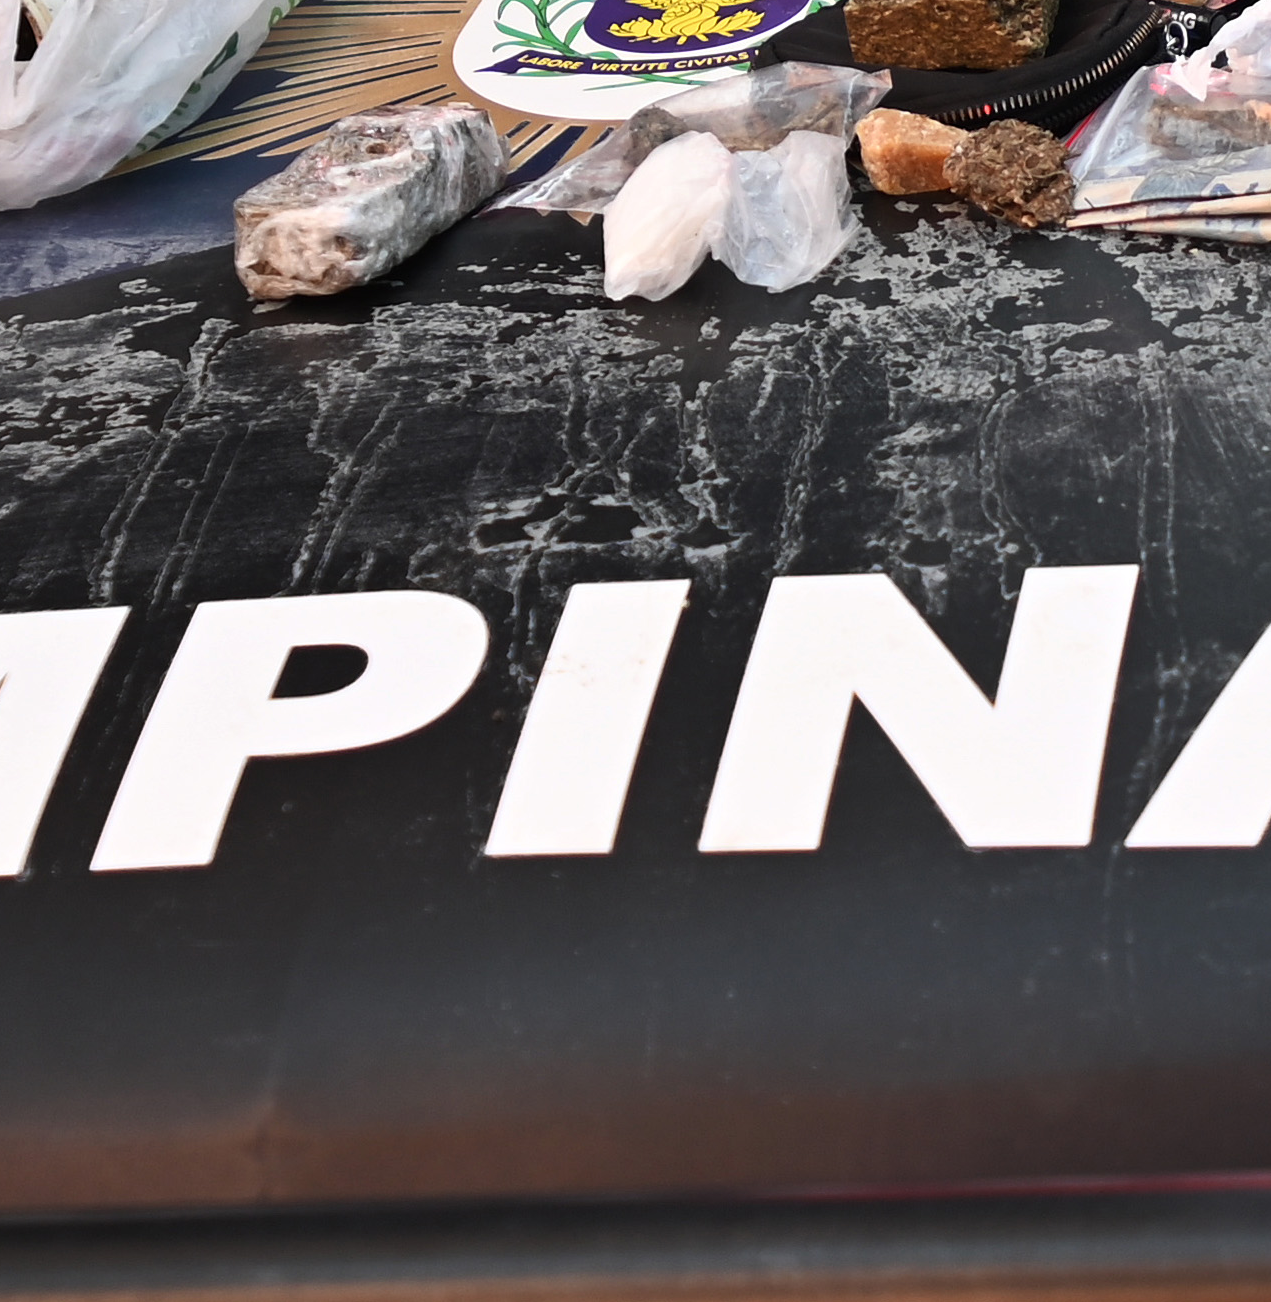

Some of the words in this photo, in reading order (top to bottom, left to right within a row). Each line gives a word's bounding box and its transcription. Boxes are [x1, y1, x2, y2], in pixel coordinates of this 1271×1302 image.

[517, 54, 585, 71] LABORE
[591, 61, 670, 73] VIRTUTE
[673, 51, 750, 70] CIVITAS
